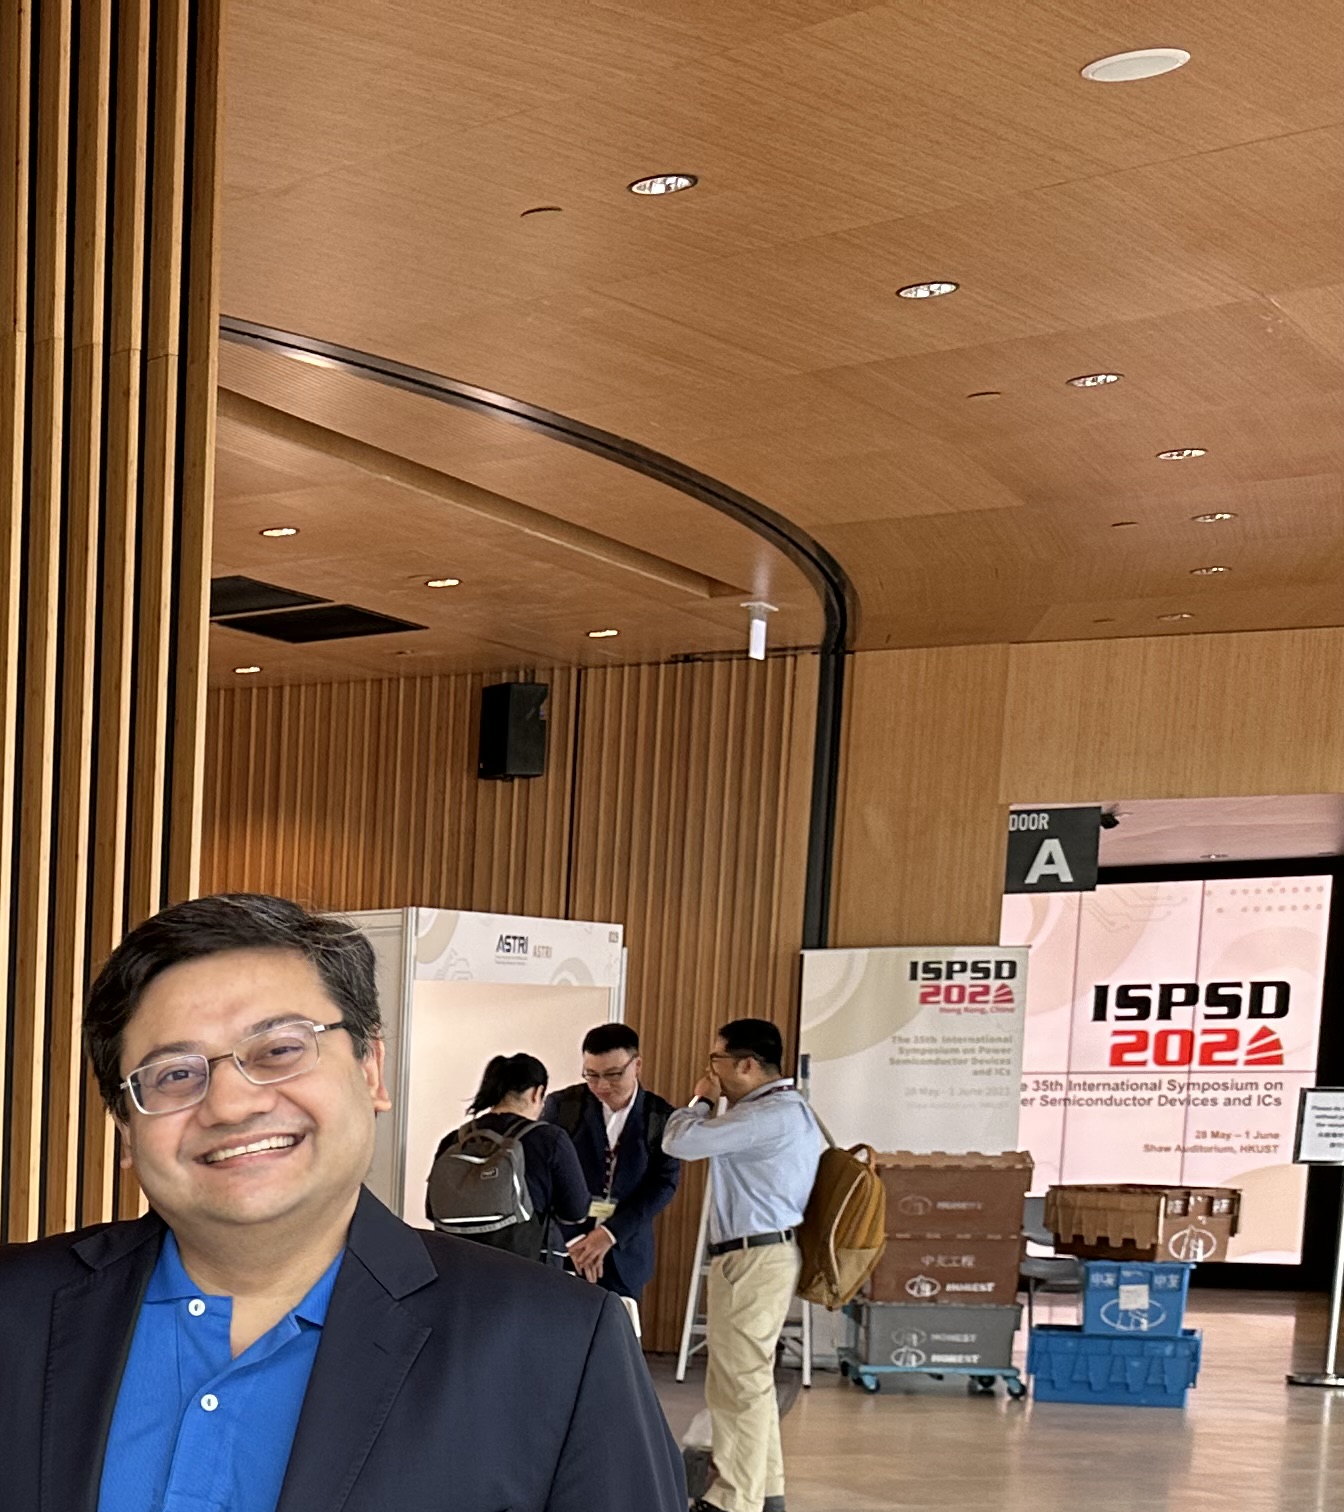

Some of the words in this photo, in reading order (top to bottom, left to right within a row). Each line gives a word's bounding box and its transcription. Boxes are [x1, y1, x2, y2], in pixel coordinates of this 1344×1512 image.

[1009, 813, 1050, 831] DOOR
[1024, 838, 1074, 884] A
[496, 934, 529, 954] ASTRI
[908, 960, 1018, 981] ISPSD
[1091, 981, 1291, 1022] ISPSD
[1032, 1080, 1064, 1092] 35th
[1068, 1079, 1162, 1092] International
[1166, 1079, 1259, 1094] Symposium
[1264, 1081, 1284, 1092] on
[1039, 1094, 1154, 1107] Semiconductor
[1157, 1094, 1219, 1107] Devices
[1223, 1094, 1253, 1107] and
[1256, 1094, 1283, 1107] ICs
